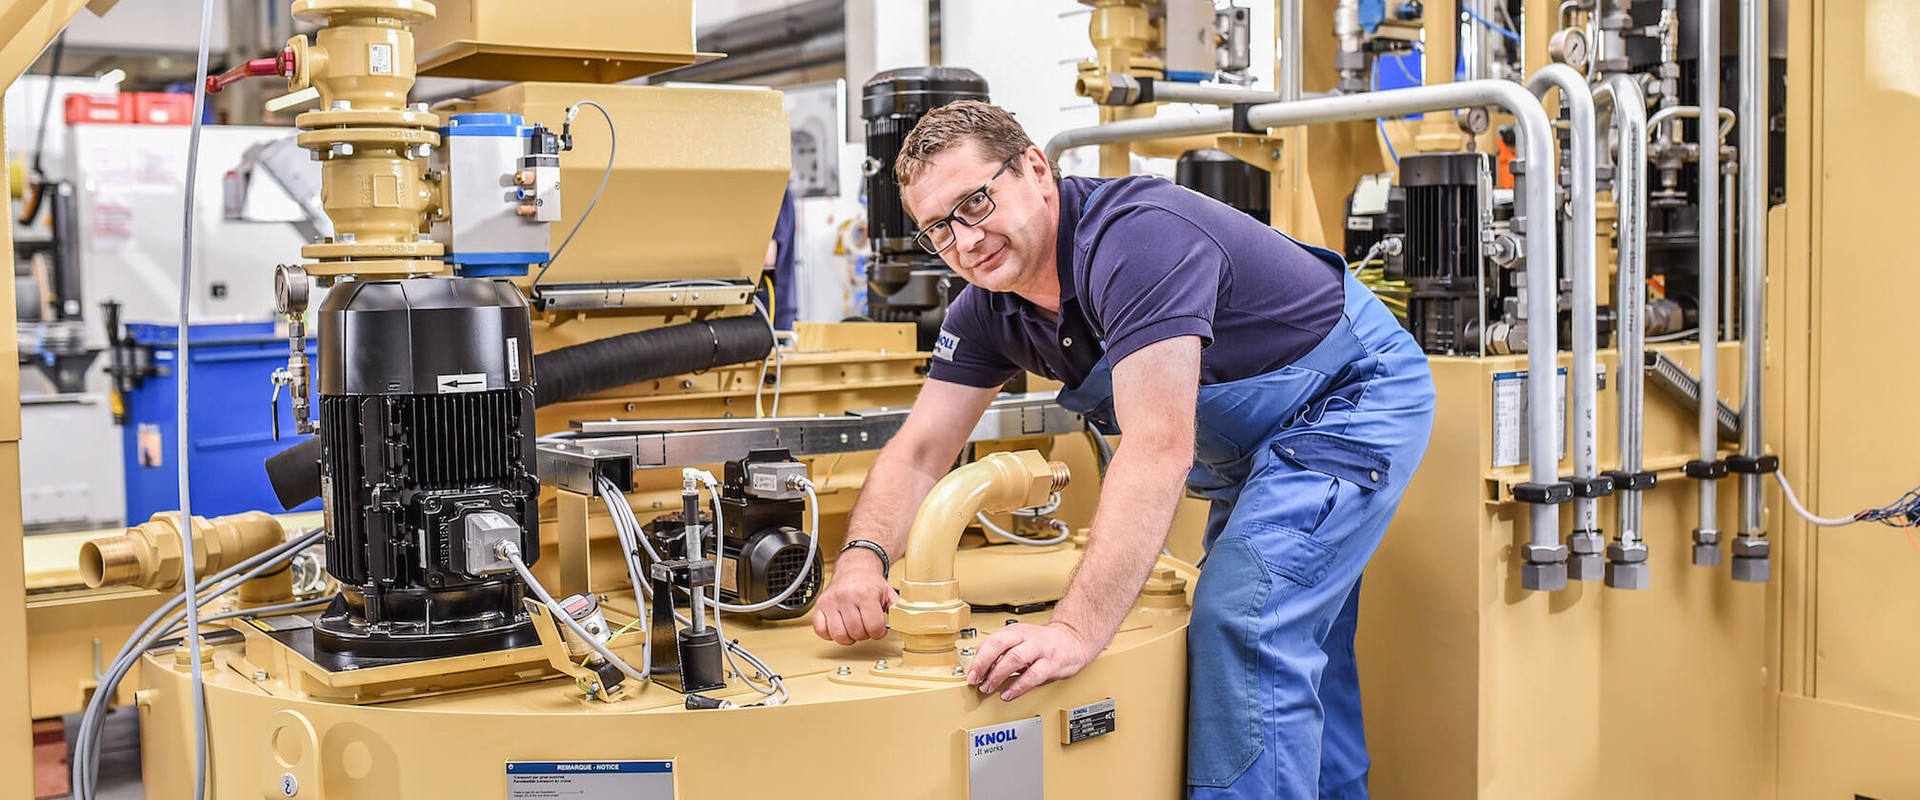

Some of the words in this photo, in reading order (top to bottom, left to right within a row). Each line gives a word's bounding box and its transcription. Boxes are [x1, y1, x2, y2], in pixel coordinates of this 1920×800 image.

[439, 515, 449, 566] SIEMENS
[975, 728, 1017, 747] KNOLL
[984, 744, 1004, 754] works
